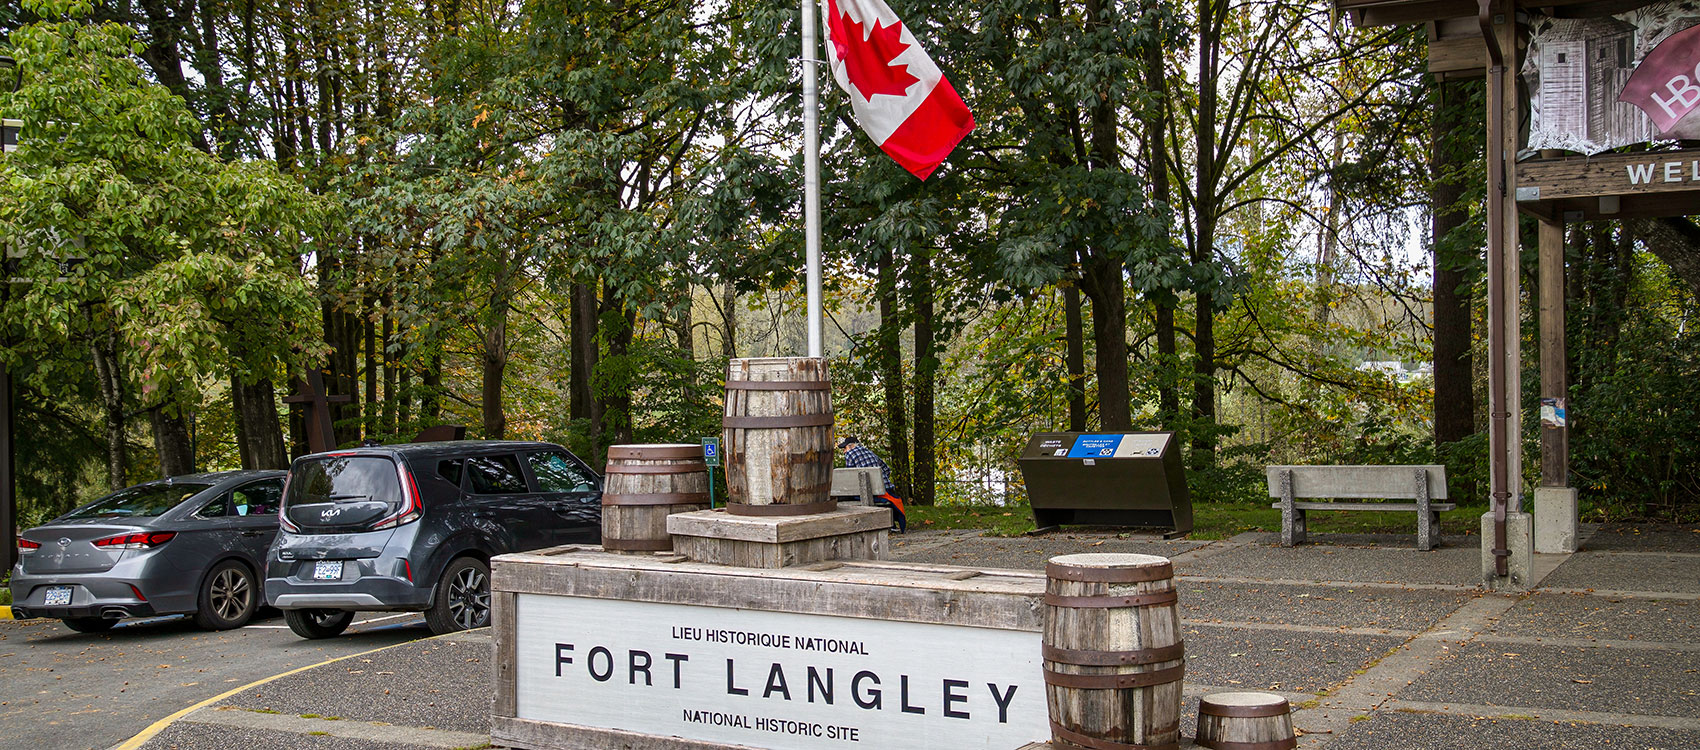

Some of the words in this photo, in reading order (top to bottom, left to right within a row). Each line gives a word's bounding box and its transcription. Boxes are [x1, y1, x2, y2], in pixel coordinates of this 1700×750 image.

[672, 626, 702, 640] LIEU
[706, 628, 791, 651] HISTORIQUE
[795, 636, 869, 656] NATIONAL
[555, 642, 689, 689] FORT
[726, 658, 1019, 724] LANGLEY
[683, 709, 752, 729] NATIONAL
[755, 717, 823, 738] HISTORIC
[826, 725, 860, 742] SITE
